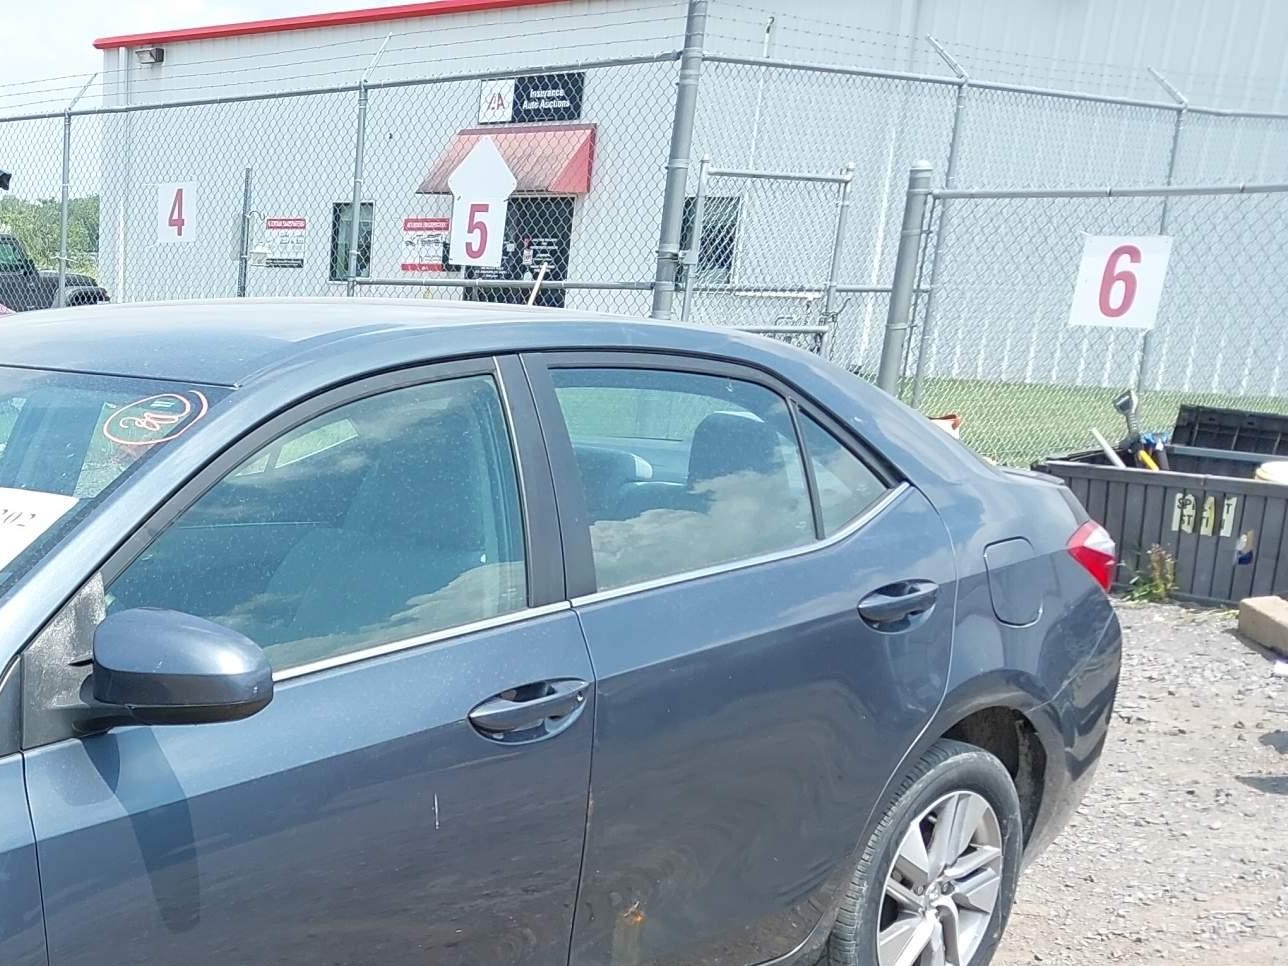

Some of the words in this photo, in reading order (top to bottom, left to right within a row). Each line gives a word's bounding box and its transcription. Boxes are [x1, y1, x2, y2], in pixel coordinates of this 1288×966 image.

[522, 100, 539, 110] Auto
[540, 99, 570, 109] Auctions
[530, 88, 564, 98] Insurance
[168, 188, 184, 236] 4
[465, 203, 489, 259] 5
[1099, 245, 1141, 317] 6
